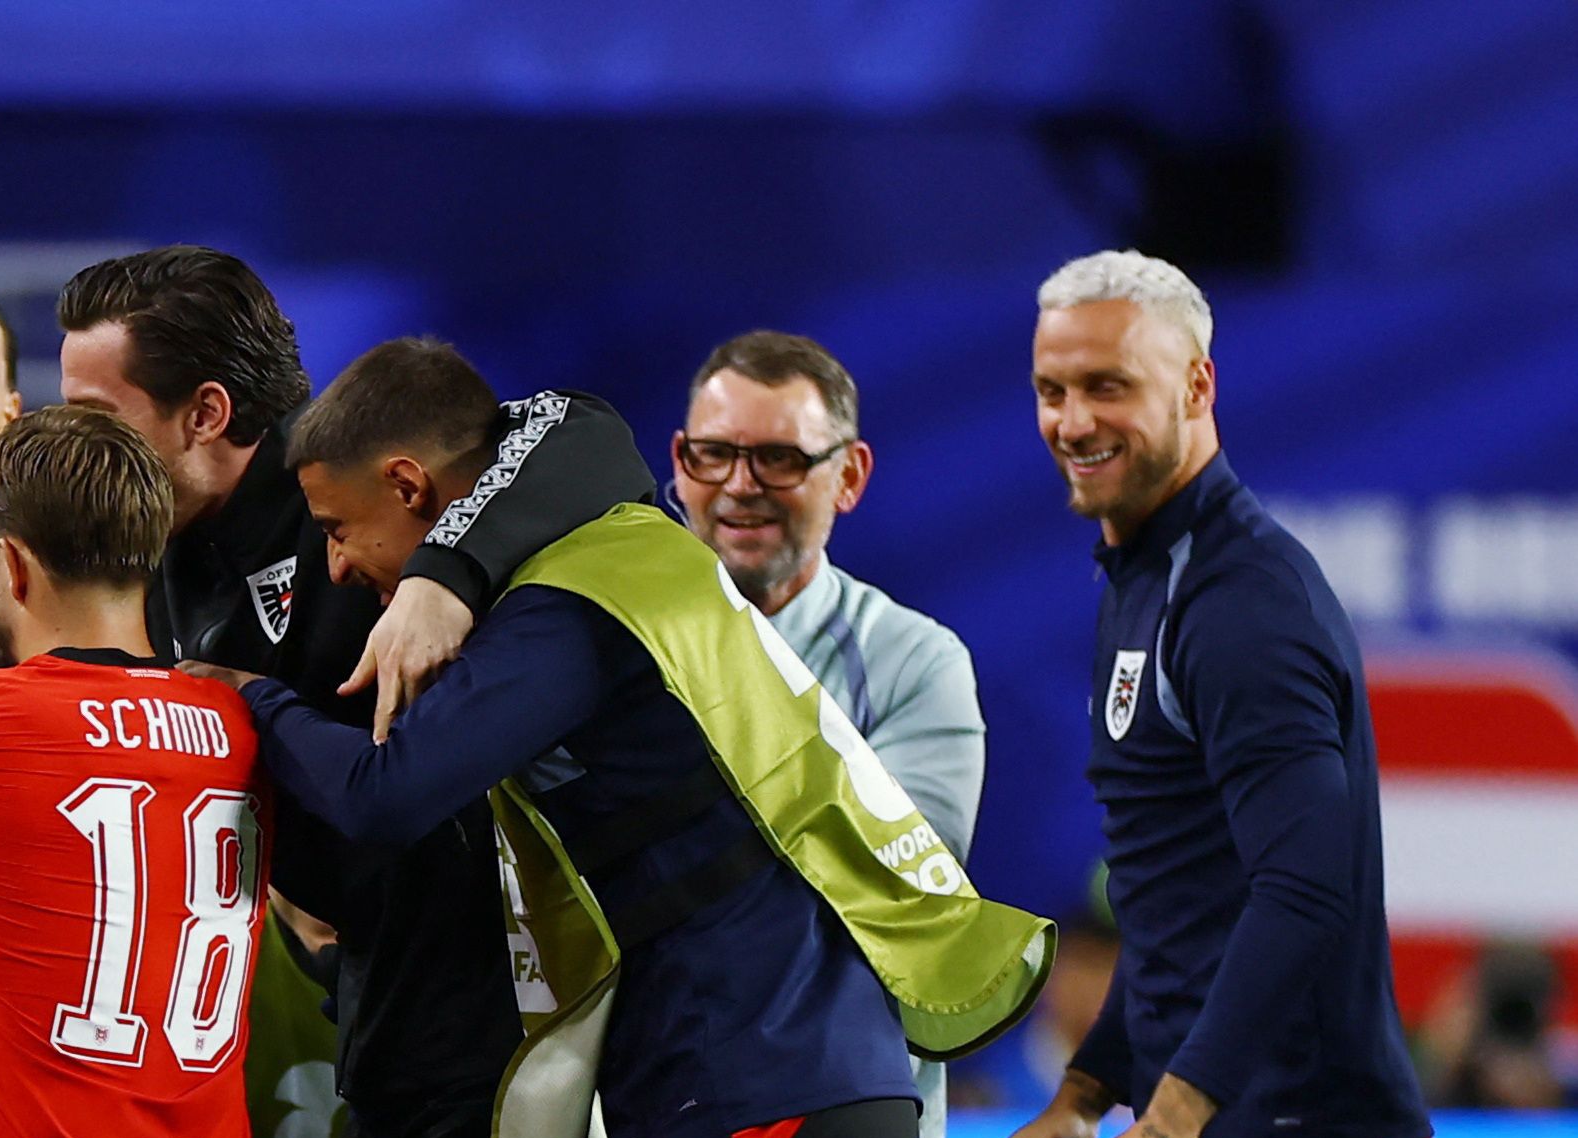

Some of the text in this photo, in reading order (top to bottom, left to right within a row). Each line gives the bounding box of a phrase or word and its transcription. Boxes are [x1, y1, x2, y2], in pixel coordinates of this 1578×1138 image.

[79, 698, 230, 759] SCHMID
[874, 821, 941, 868] WORL
[50, 777, 263, 1073] 18
[514, 951, 545, 983] FA
